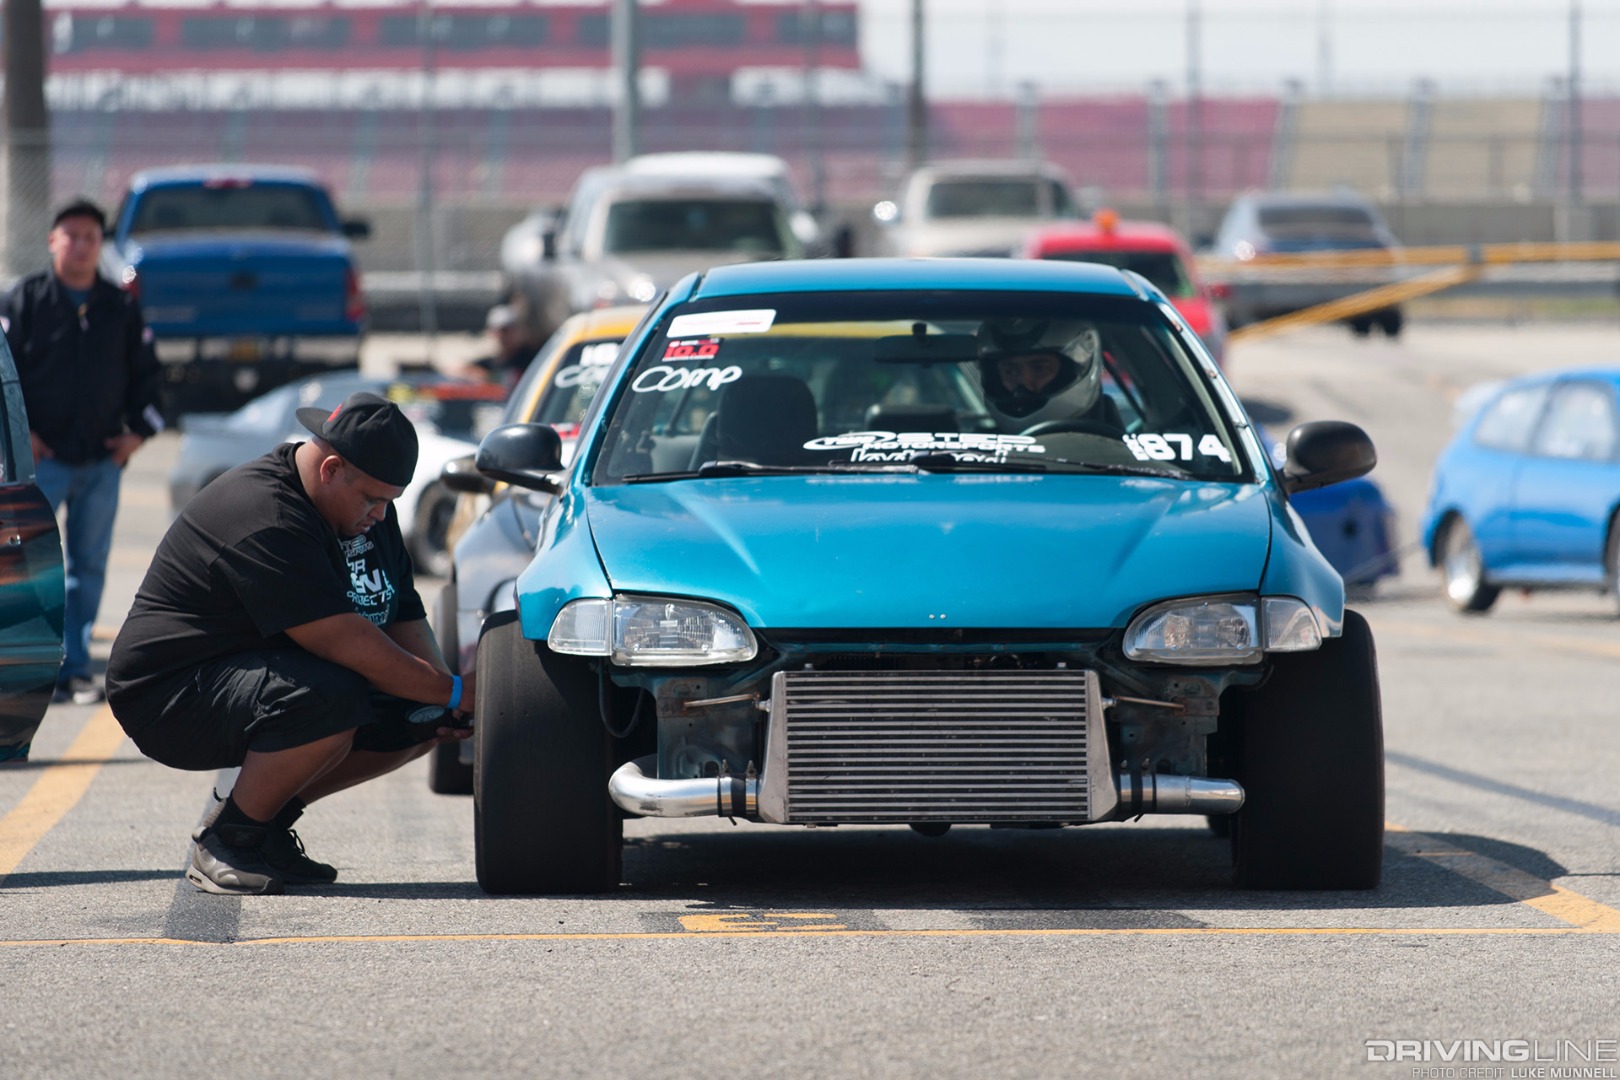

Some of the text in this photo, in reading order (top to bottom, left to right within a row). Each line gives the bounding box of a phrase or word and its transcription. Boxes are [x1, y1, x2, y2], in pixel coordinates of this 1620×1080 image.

[632, 365, 743, 393] Comp
[863, 441, 1046, 453] MOTORSPORTS
[897, 432, 1037, 444] STEP
[1137, 433, 1232, 462] 874
